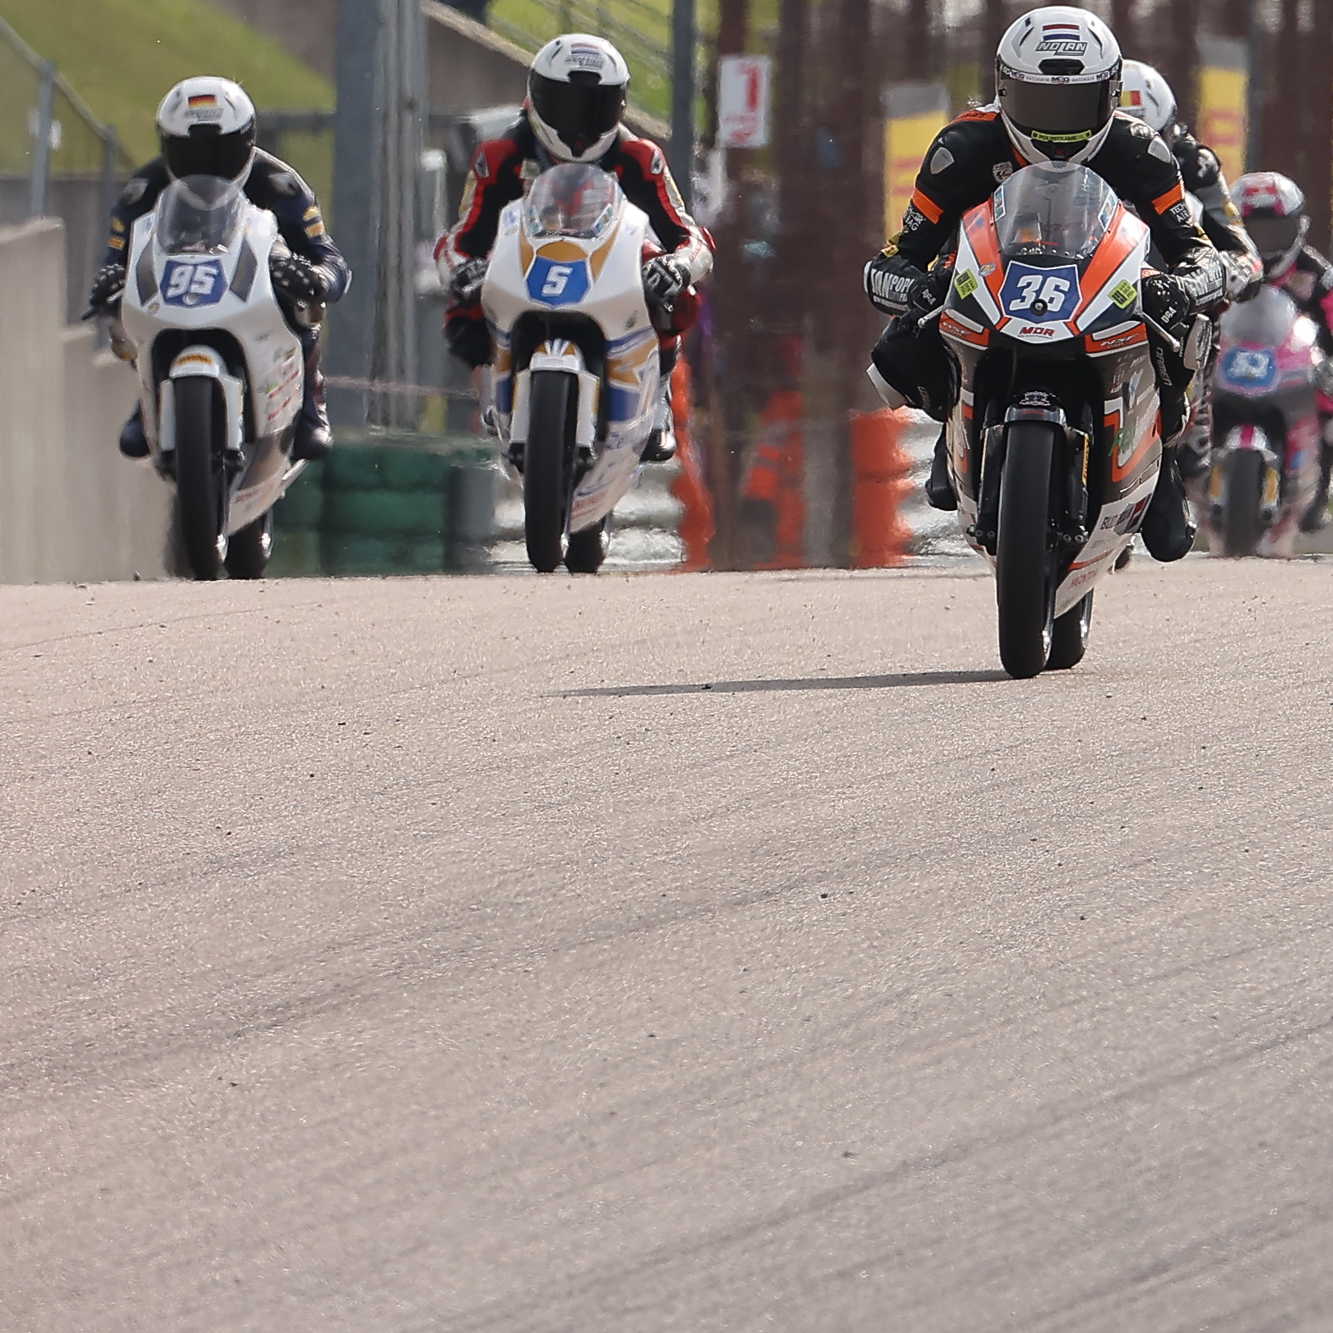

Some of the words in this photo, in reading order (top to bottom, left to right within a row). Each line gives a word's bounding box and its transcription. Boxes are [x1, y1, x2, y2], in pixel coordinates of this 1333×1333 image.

[1035, 42, 1088, 56] NOLAN
[167, 266, 218, 297] 95
[541, 266, 572, 297] 5
[1009, 275, 1070, 312] 36
